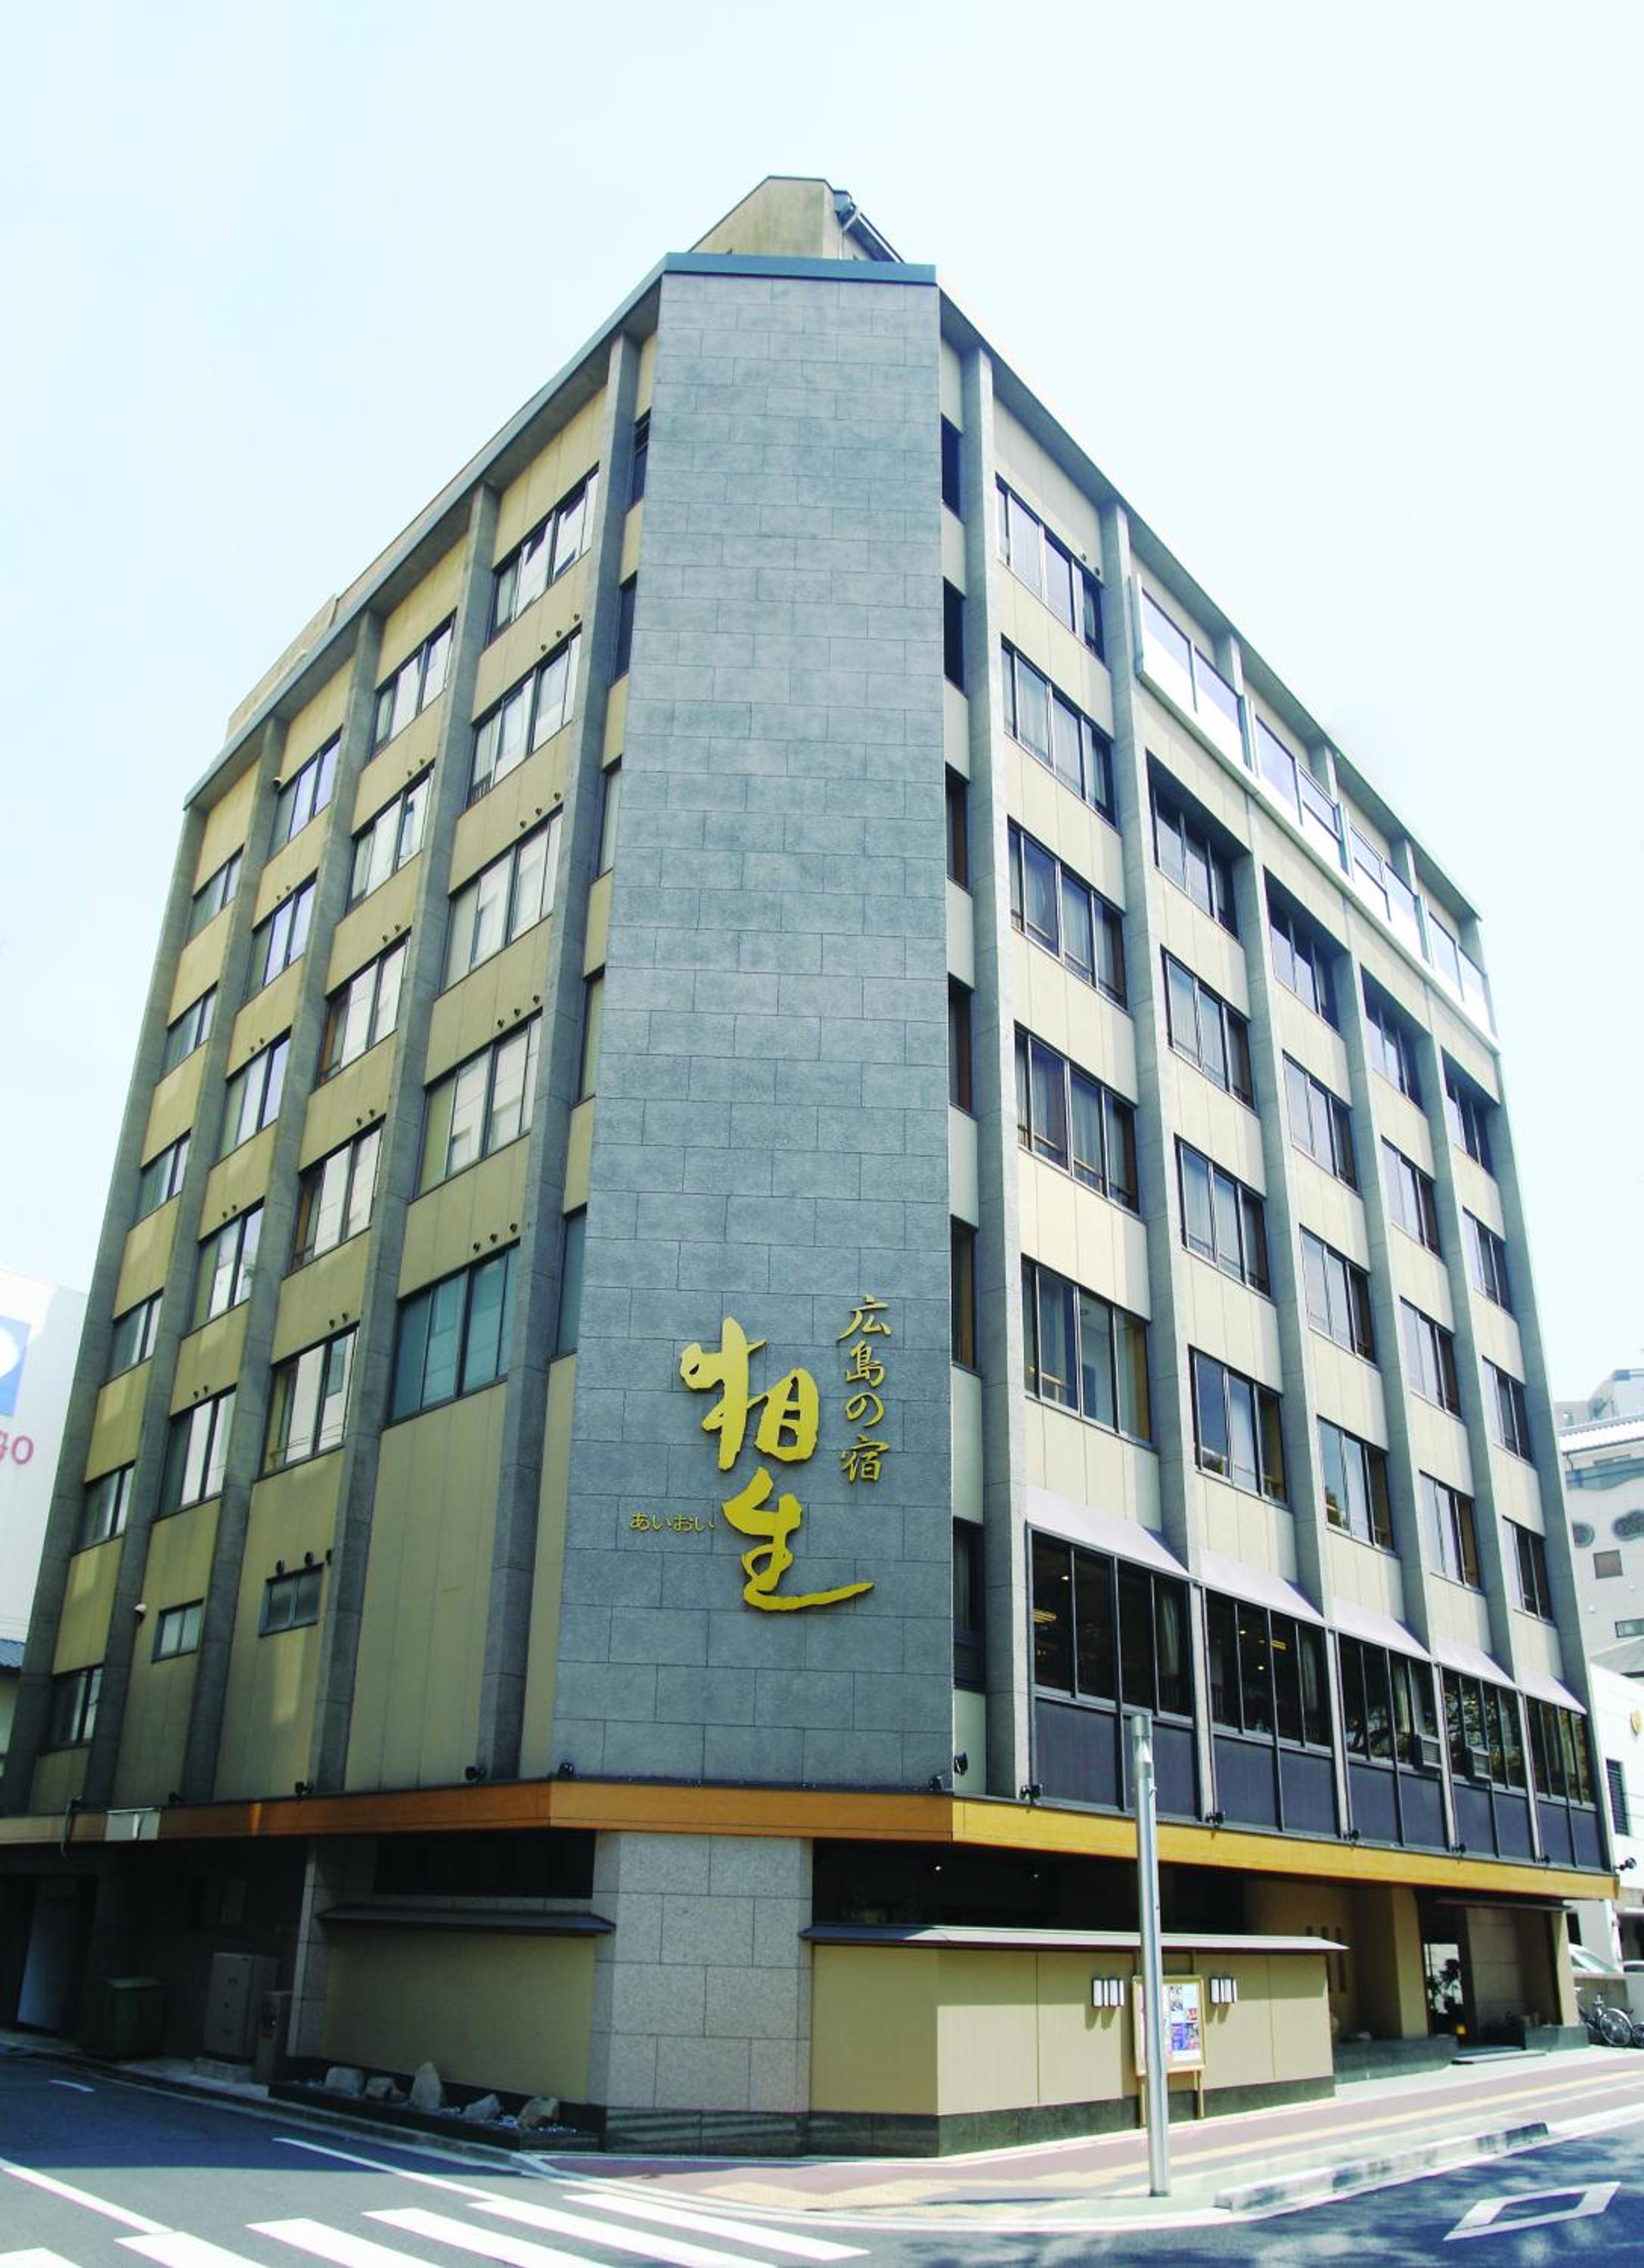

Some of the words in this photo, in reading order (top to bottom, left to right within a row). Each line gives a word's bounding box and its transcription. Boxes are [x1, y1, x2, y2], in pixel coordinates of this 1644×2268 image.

[680, 1316, 874, 1611] 相生
[838, 1294, 892, 1483] 広島の宿
[629, 1511, 715, 1532] あいおい
